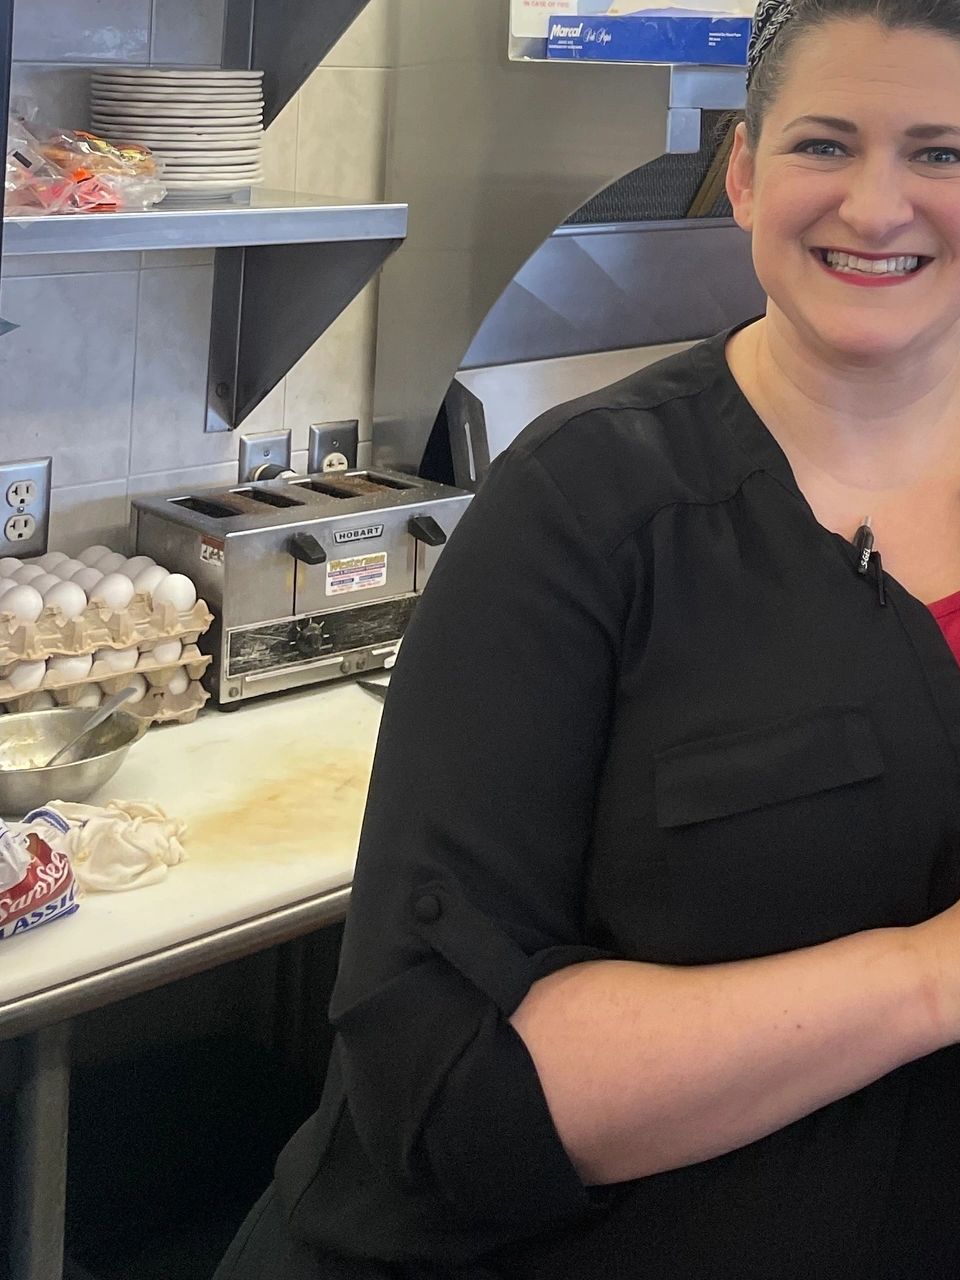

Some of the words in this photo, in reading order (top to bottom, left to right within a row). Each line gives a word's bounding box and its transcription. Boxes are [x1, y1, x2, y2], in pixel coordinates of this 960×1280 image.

[531, 0, 547, 8] CASE
[547, 0, 557, 8] OF
[550, 22, 584, 40] Marcal
[339, 526, 380, 540] HOBART
